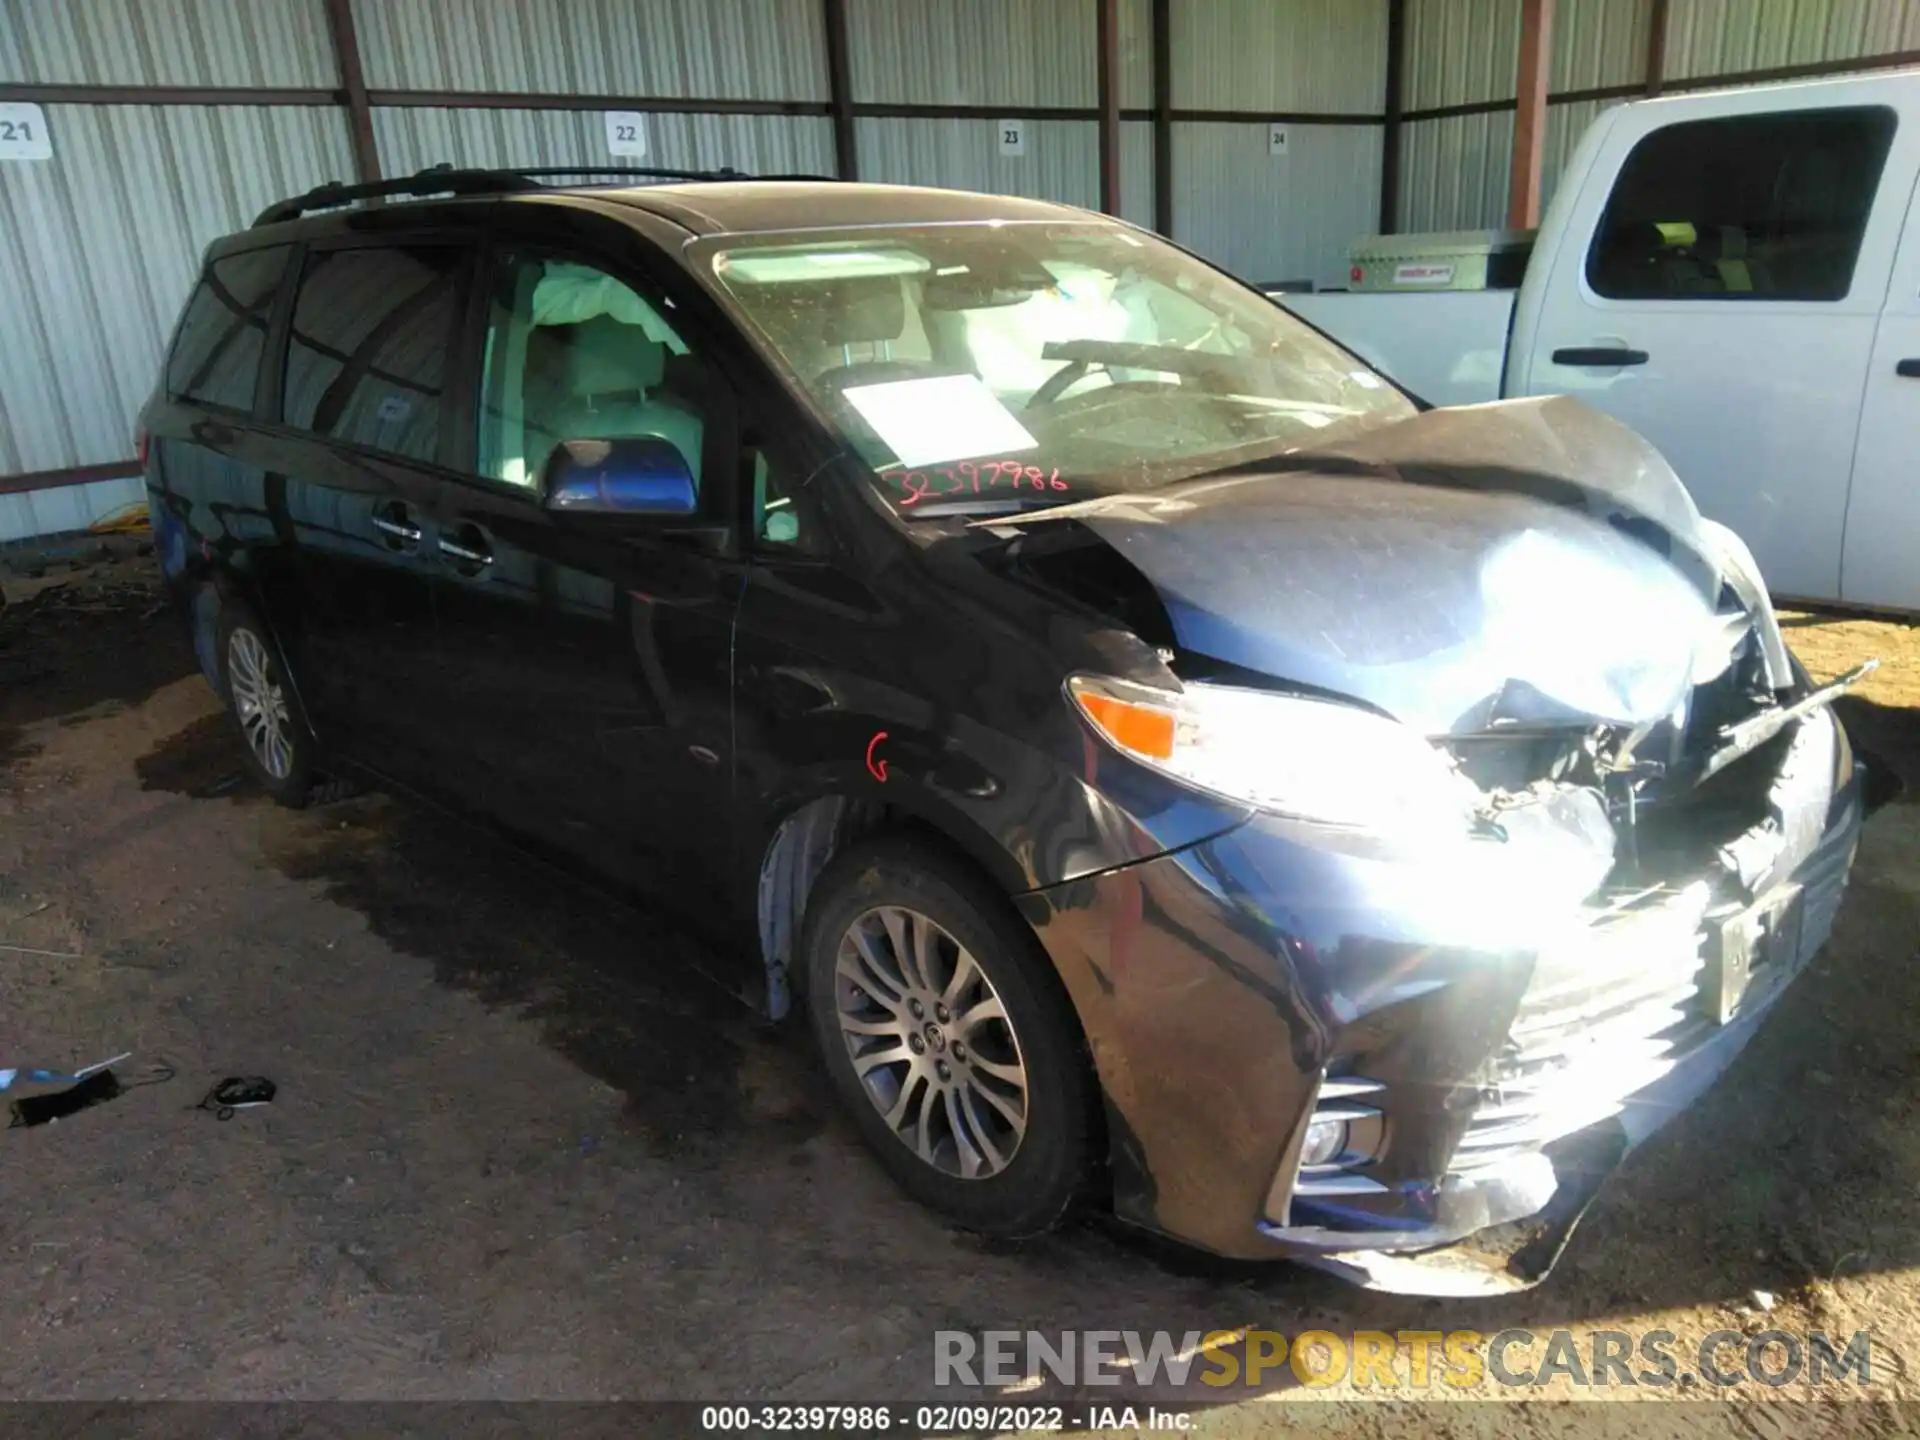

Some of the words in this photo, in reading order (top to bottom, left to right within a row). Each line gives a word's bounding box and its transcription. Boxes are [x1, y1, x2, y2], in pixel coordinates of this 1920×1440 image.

[0, 120, 33, 141] 21
[616, 125, 637, 141] 22
[1004, 130, 1019, 144] 23
[1273, 132, 1285, 145] 24
